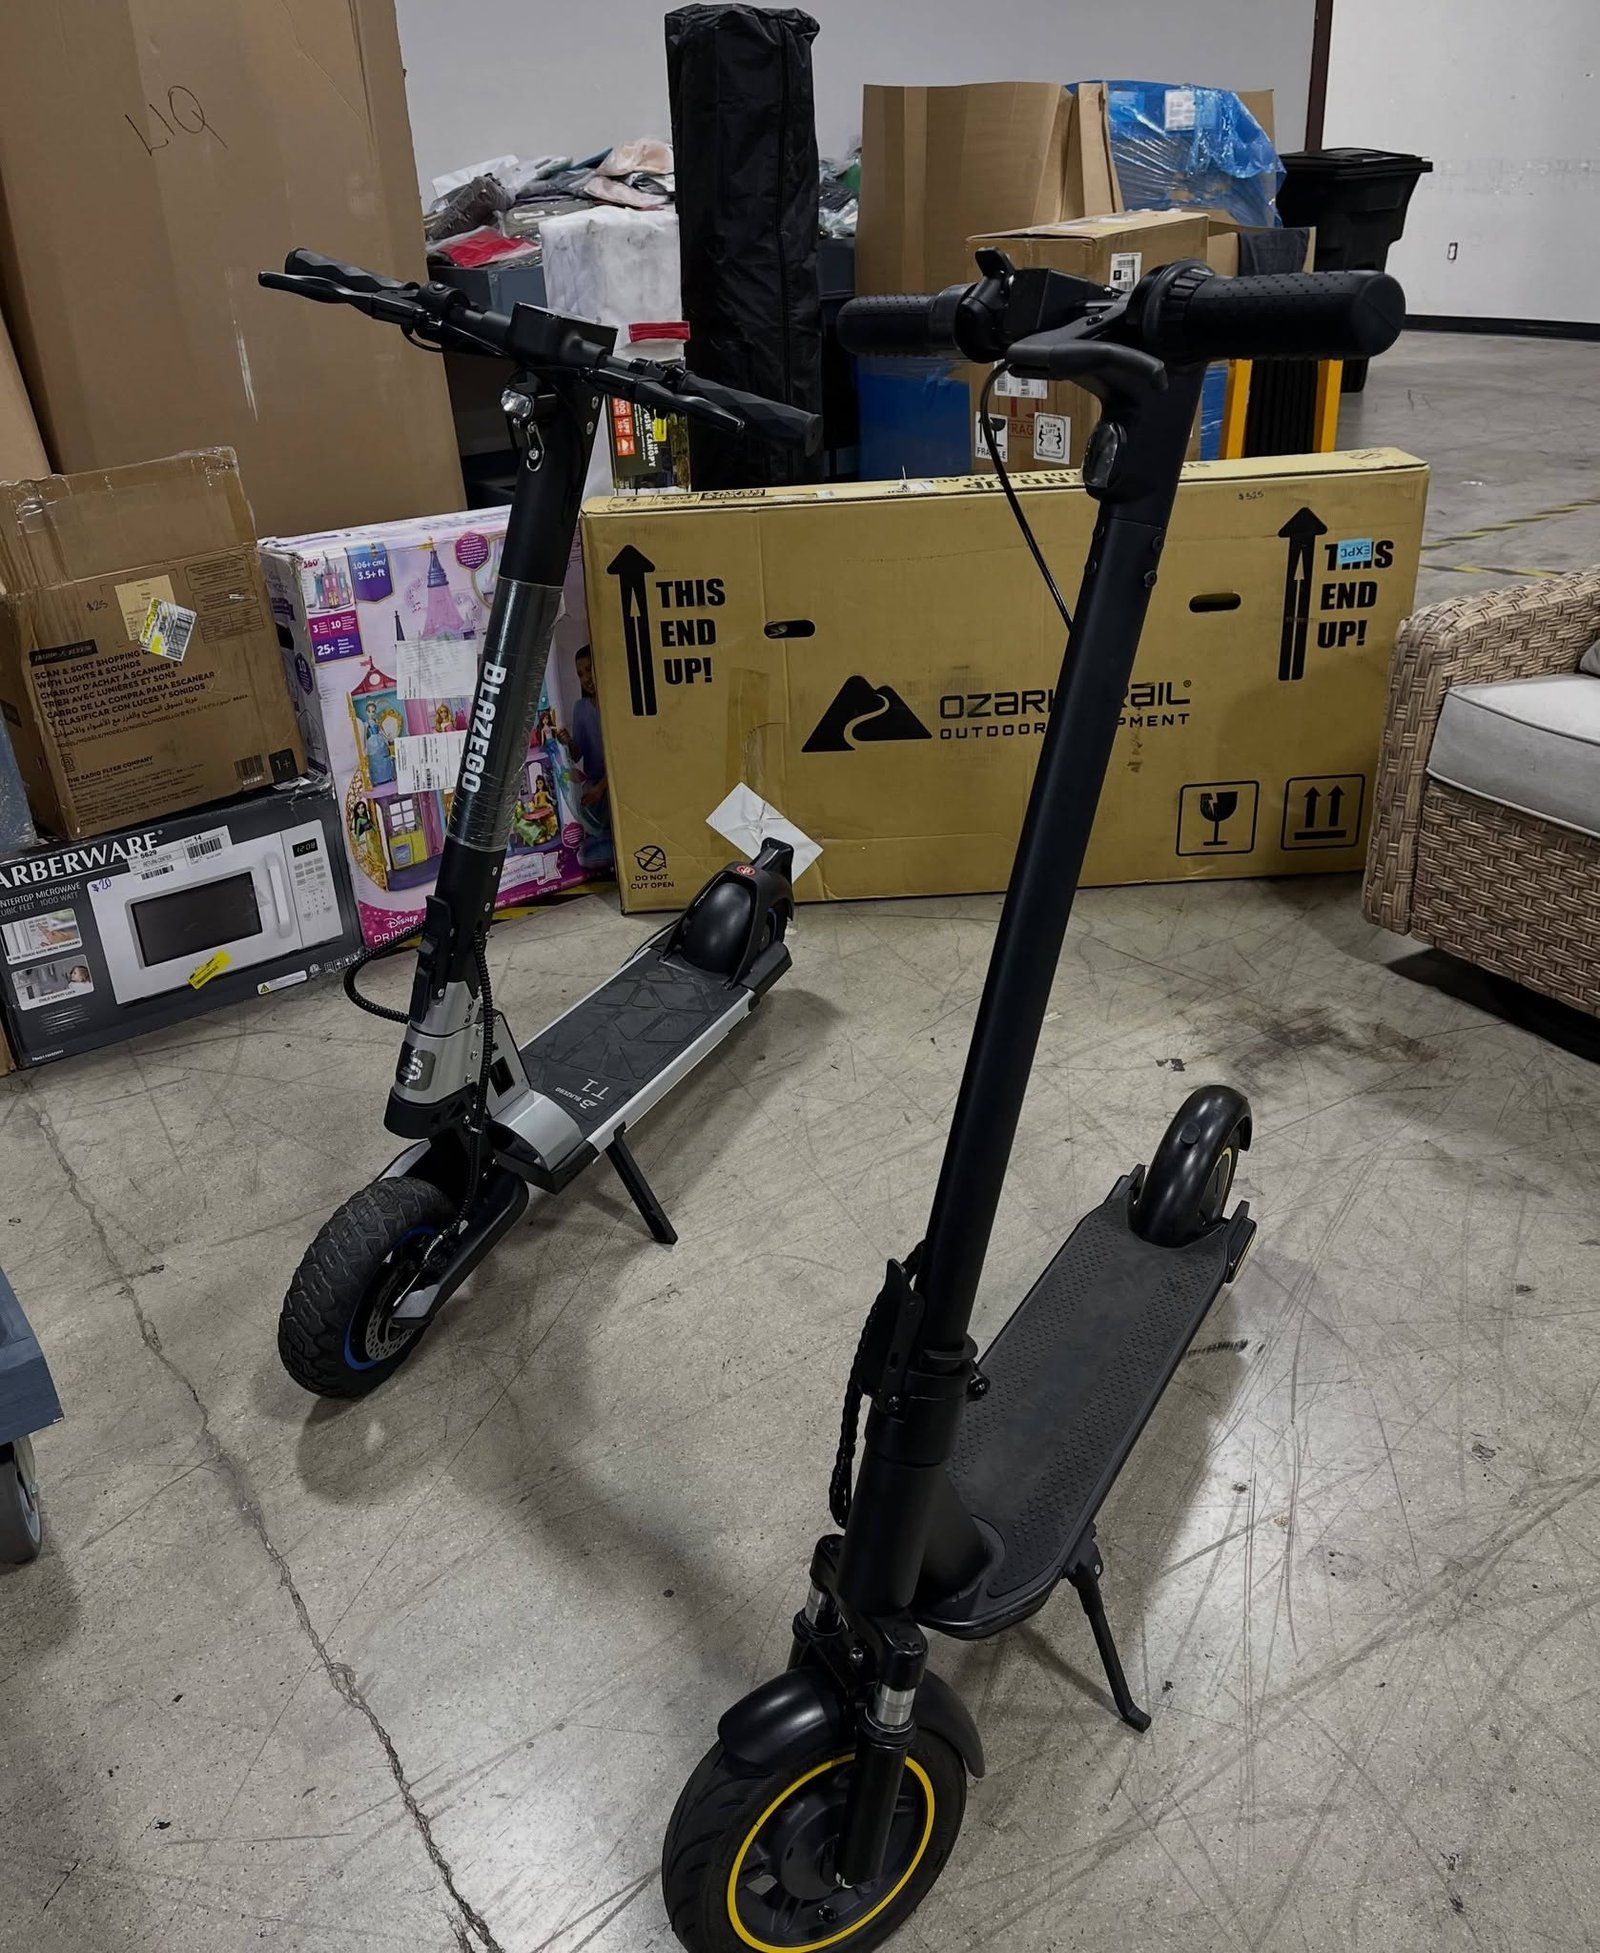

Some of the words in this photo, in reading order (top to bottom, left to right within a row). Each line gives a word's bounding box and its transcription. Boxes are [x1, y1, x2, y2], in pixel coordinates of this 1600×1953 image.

[358, 570, 377, 580] 3.5+
[378, 568, 386, 578] ft
[655, 578, 726, 608] THIS
[1320, 581, 1377, 611] END
[313, 624, 319, 633] 3
[331, 620, 341, 629] 10
[660, 619, 717, 647] END
[1317, 620, 1367, 649] UP!
[317, 643, 335, 656] 25+
[34, 668, 60, 680] SCAN
[62, 667, 69, 675] &
[71, 661, 95, 673] SORT
[97, 650, 140, 667] SHOPPING
[37, 677, 62, 689] WITH
[64, 671, 96, 684] LIGHTS
[97, 668, 104, 676] &
[105, 660, 141, 674] SOUNDS
[663, 657, 712, 685] UP!
[40, 687, 80, 699] CHARIOT
[83, 677, 121, 691] D'ACHAT
[131, 664, 171, 679] SCANNER
[43, 697, 69, 709] TRIER
[72, 693, 95, 704] AVEC
[141, 677, 152, 686] ET
[153, 671, 176, 682] SONS
[47, 706, 78, 719] CARRO
[81, 704, 93, 713] DE
[95, 700, 107, 709] LA
[108, 691, 144, 706] COMPRA
[147, 684, 169, 695] PARA
[171, 671, 215, 688] ESCANEAR
[57, 709, 110, 726] CLASIFICAR
[112, 702, 131, 714] CON
[132, 695, 159, 709] LUCES
[169, 683, 206, 698] SONIDOS
[462, 660, 507, 793] BLAZEGO
[122, 756, 153, 772] COMPANY
[275, 760, 291, 772] 1+
[36, 882, 81, 899] MICROWAVE
[635, 874, 648, 882] DO
[649, 873, 668, 881] NOT
[650, 881, 674, 889] OPEN
[19, 902, 35, 912] FEET
[40, 897, 59, 907] 1000
[59, 891, 78, 901] WATT
[581, 1078, 610, 1100] T1
